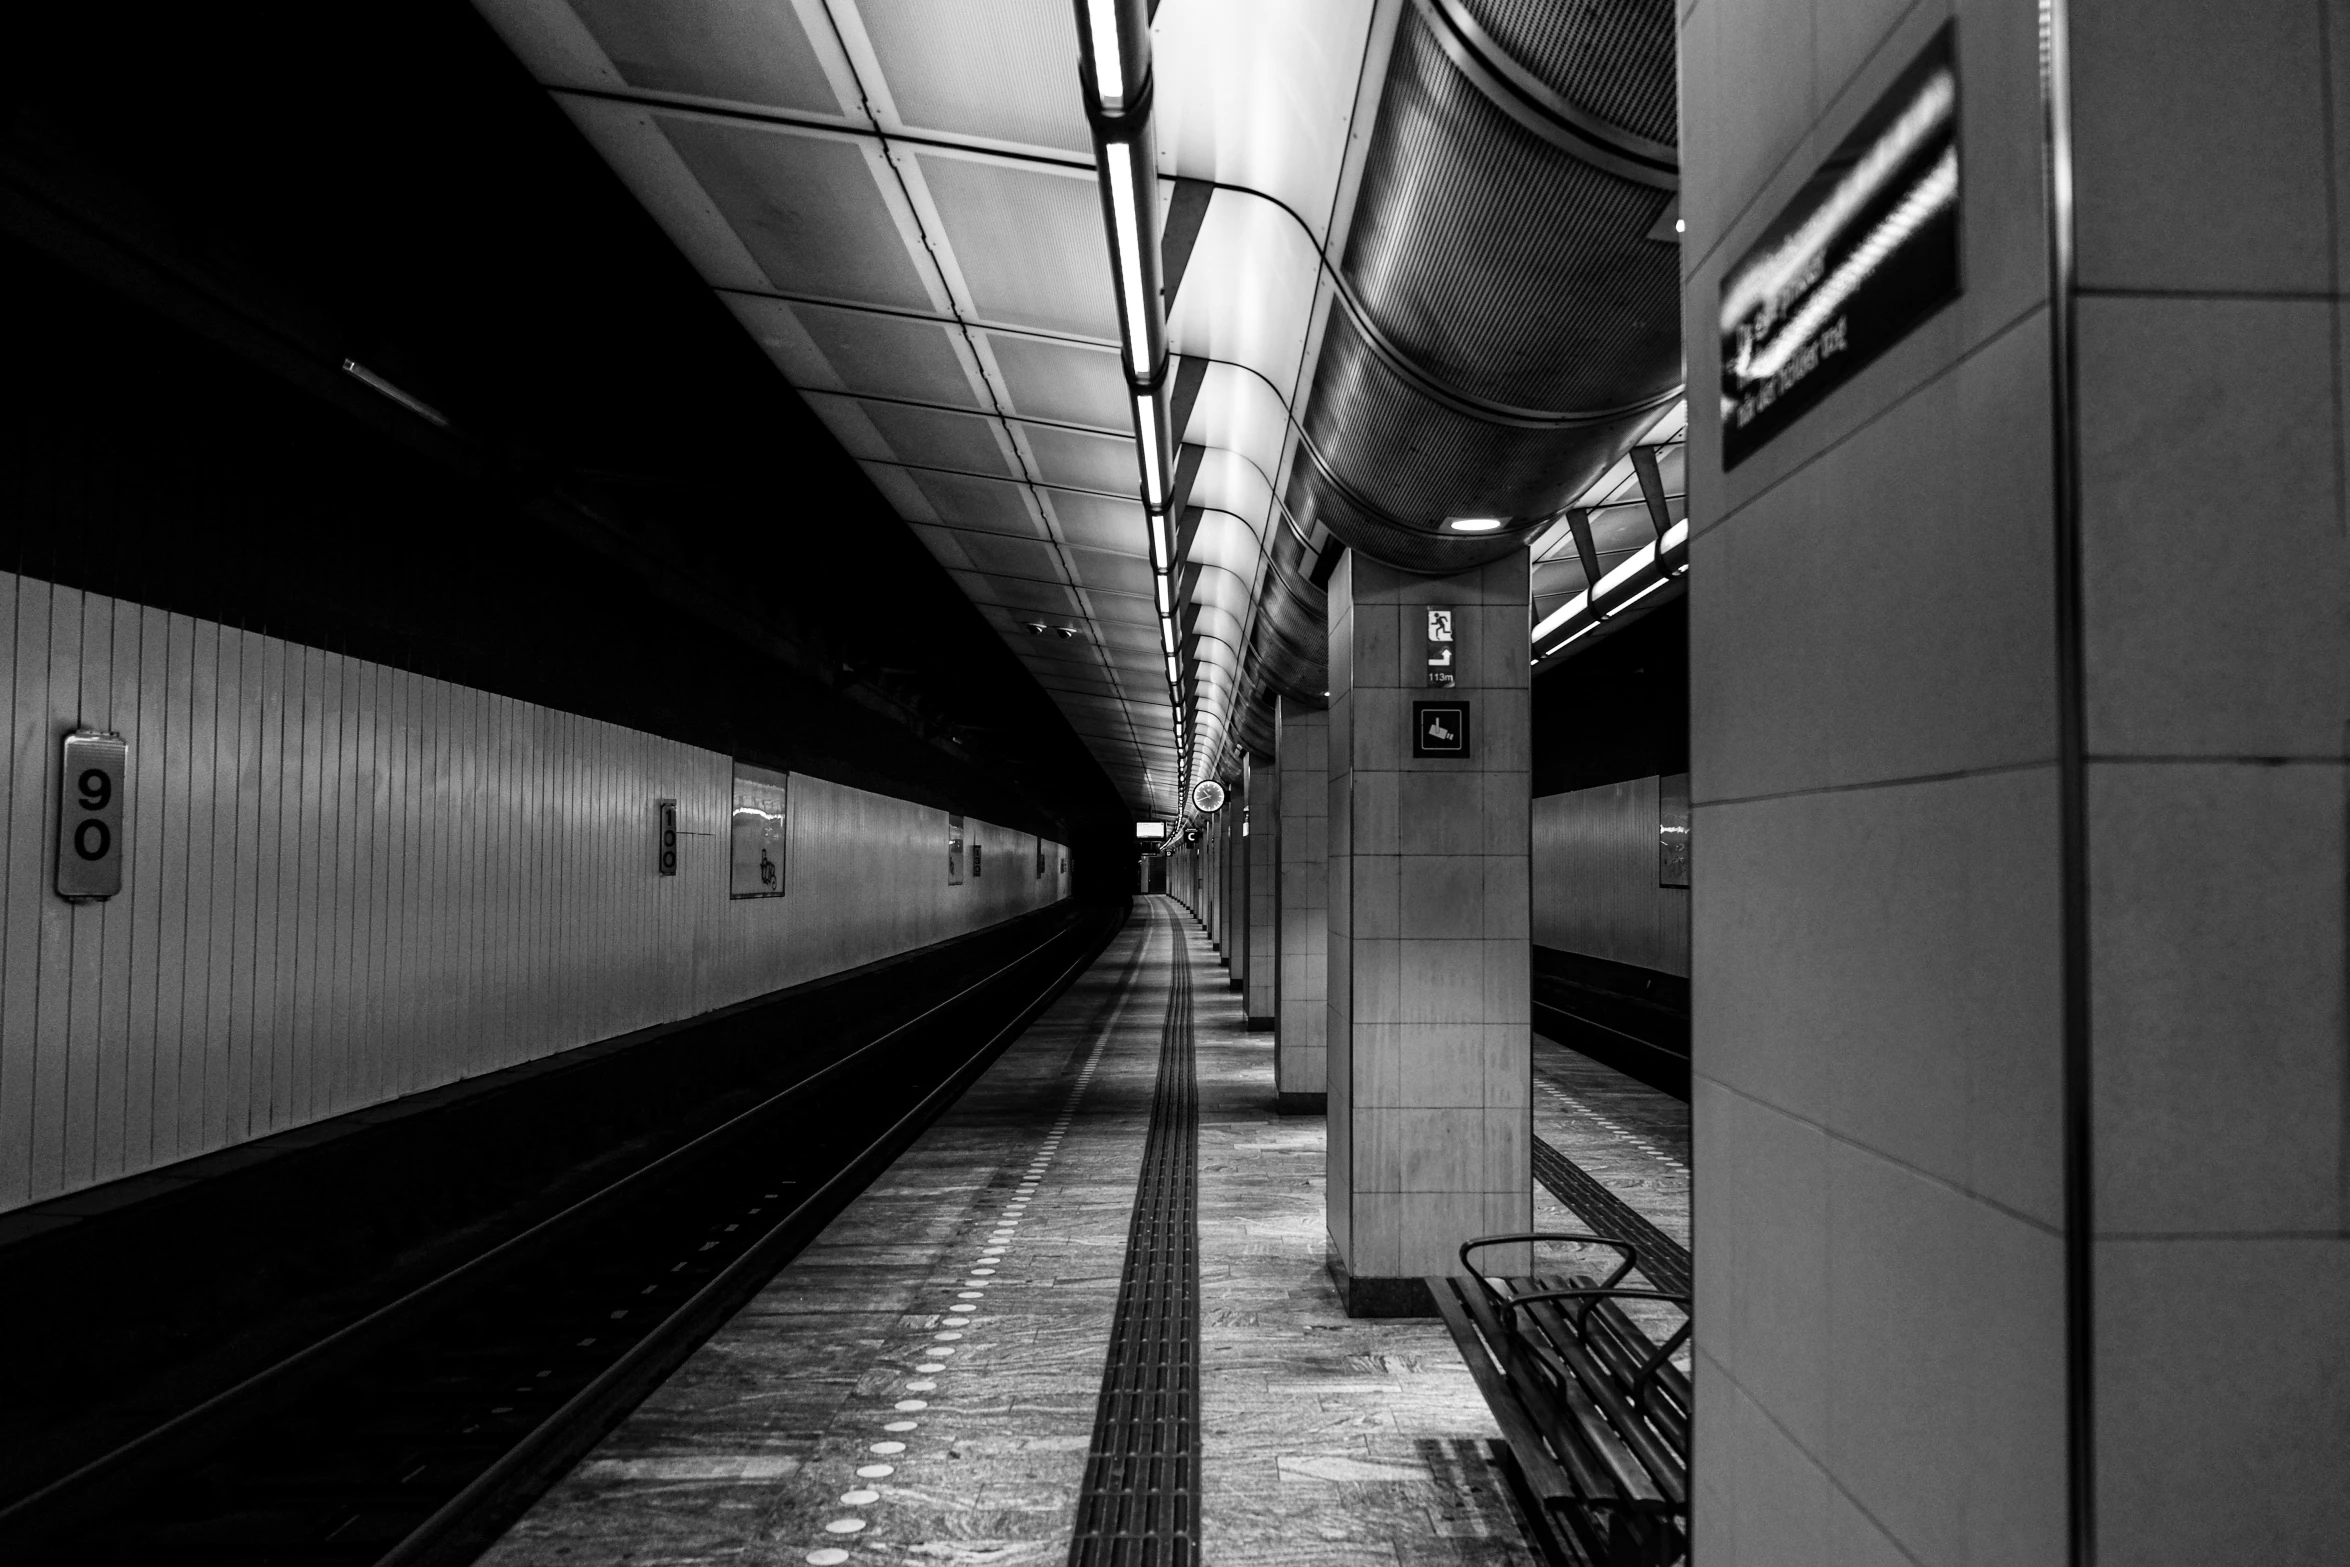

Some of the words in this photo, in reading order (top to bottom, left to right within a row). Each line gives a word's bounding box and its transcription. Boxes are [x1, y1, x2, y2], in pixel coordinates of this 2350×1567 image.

[1428, 672, 1453, 682] 113m
[74, 768, 111, 861] 90
[663, 809, 676, 868] 100
[1188, 832, 1195, 841] C
